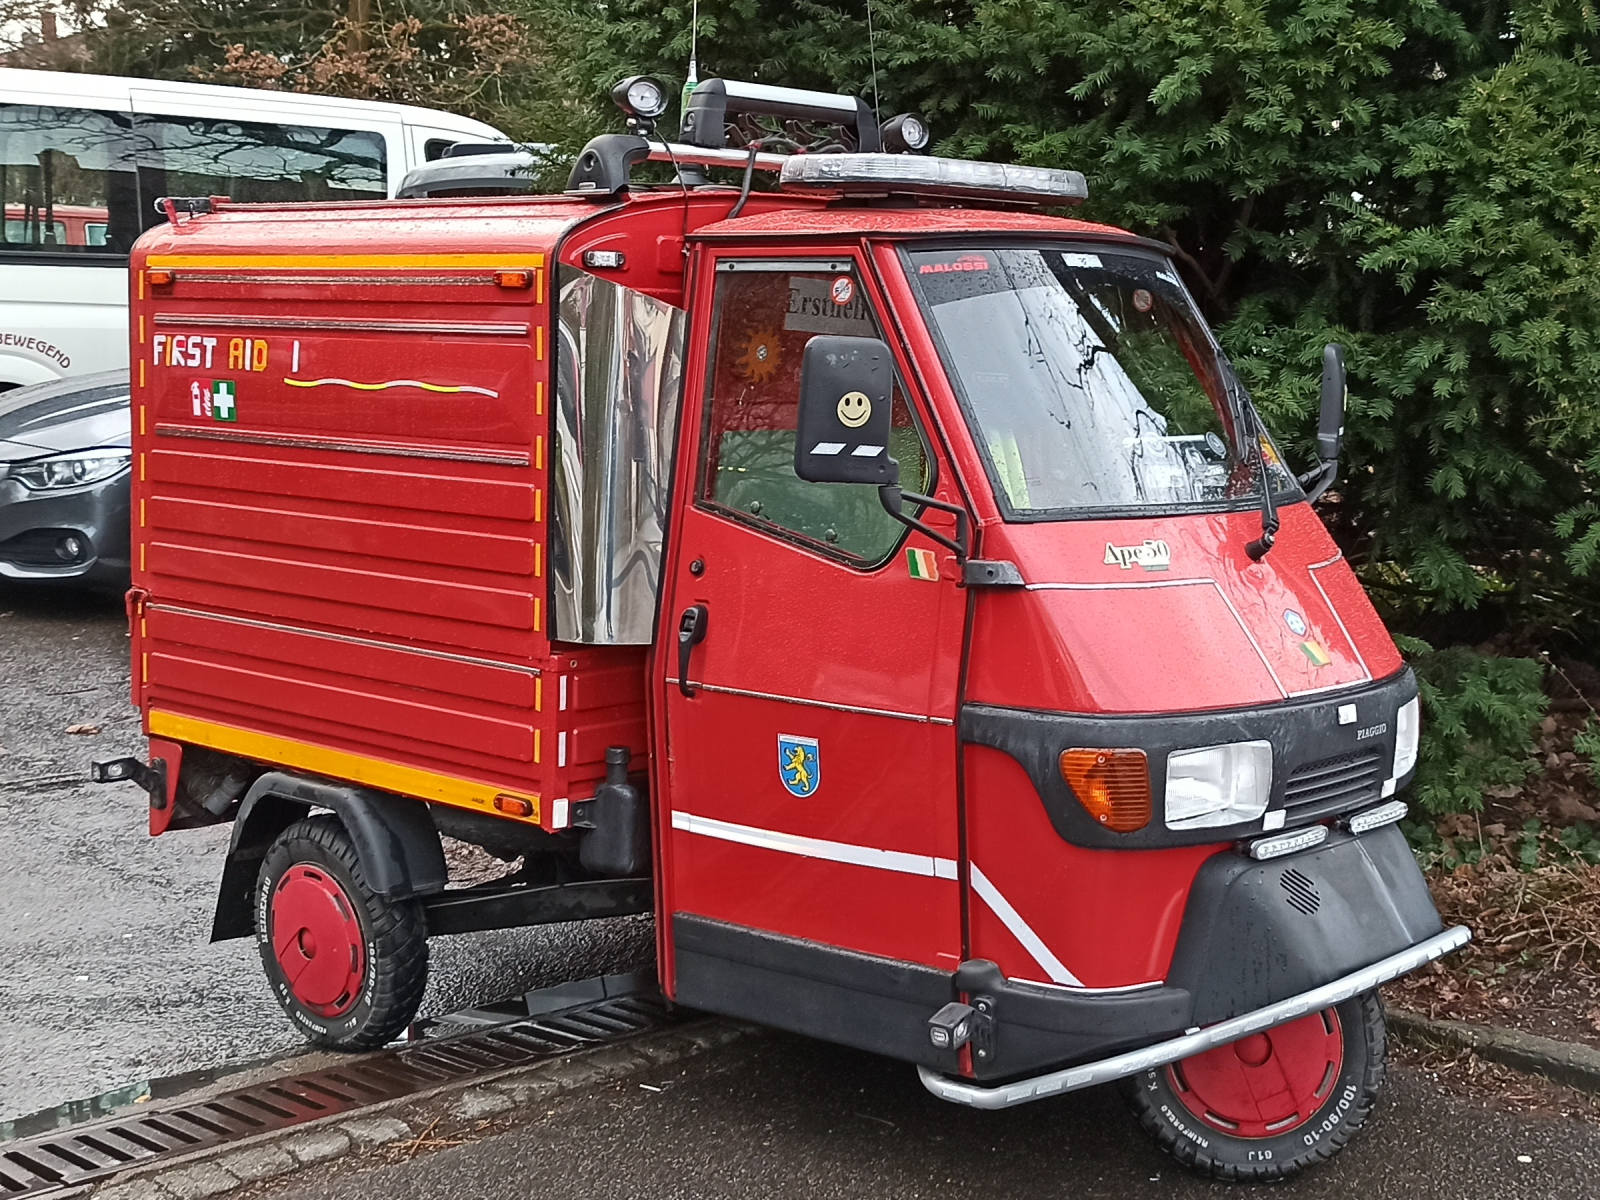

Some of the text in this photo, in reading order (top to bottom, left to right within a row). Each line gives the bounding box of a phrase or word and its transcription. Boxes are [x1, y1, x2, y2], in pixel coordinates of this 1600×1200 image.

[919, 262, 989, 275] MALOSSI
[153, 335, 217, 369] FIRST
[229, 338, 268, 371] AID
[1357, 723, 1387, 740] PIAGGIO
[1303, 1084, 1357, 1146] 100/90-10
